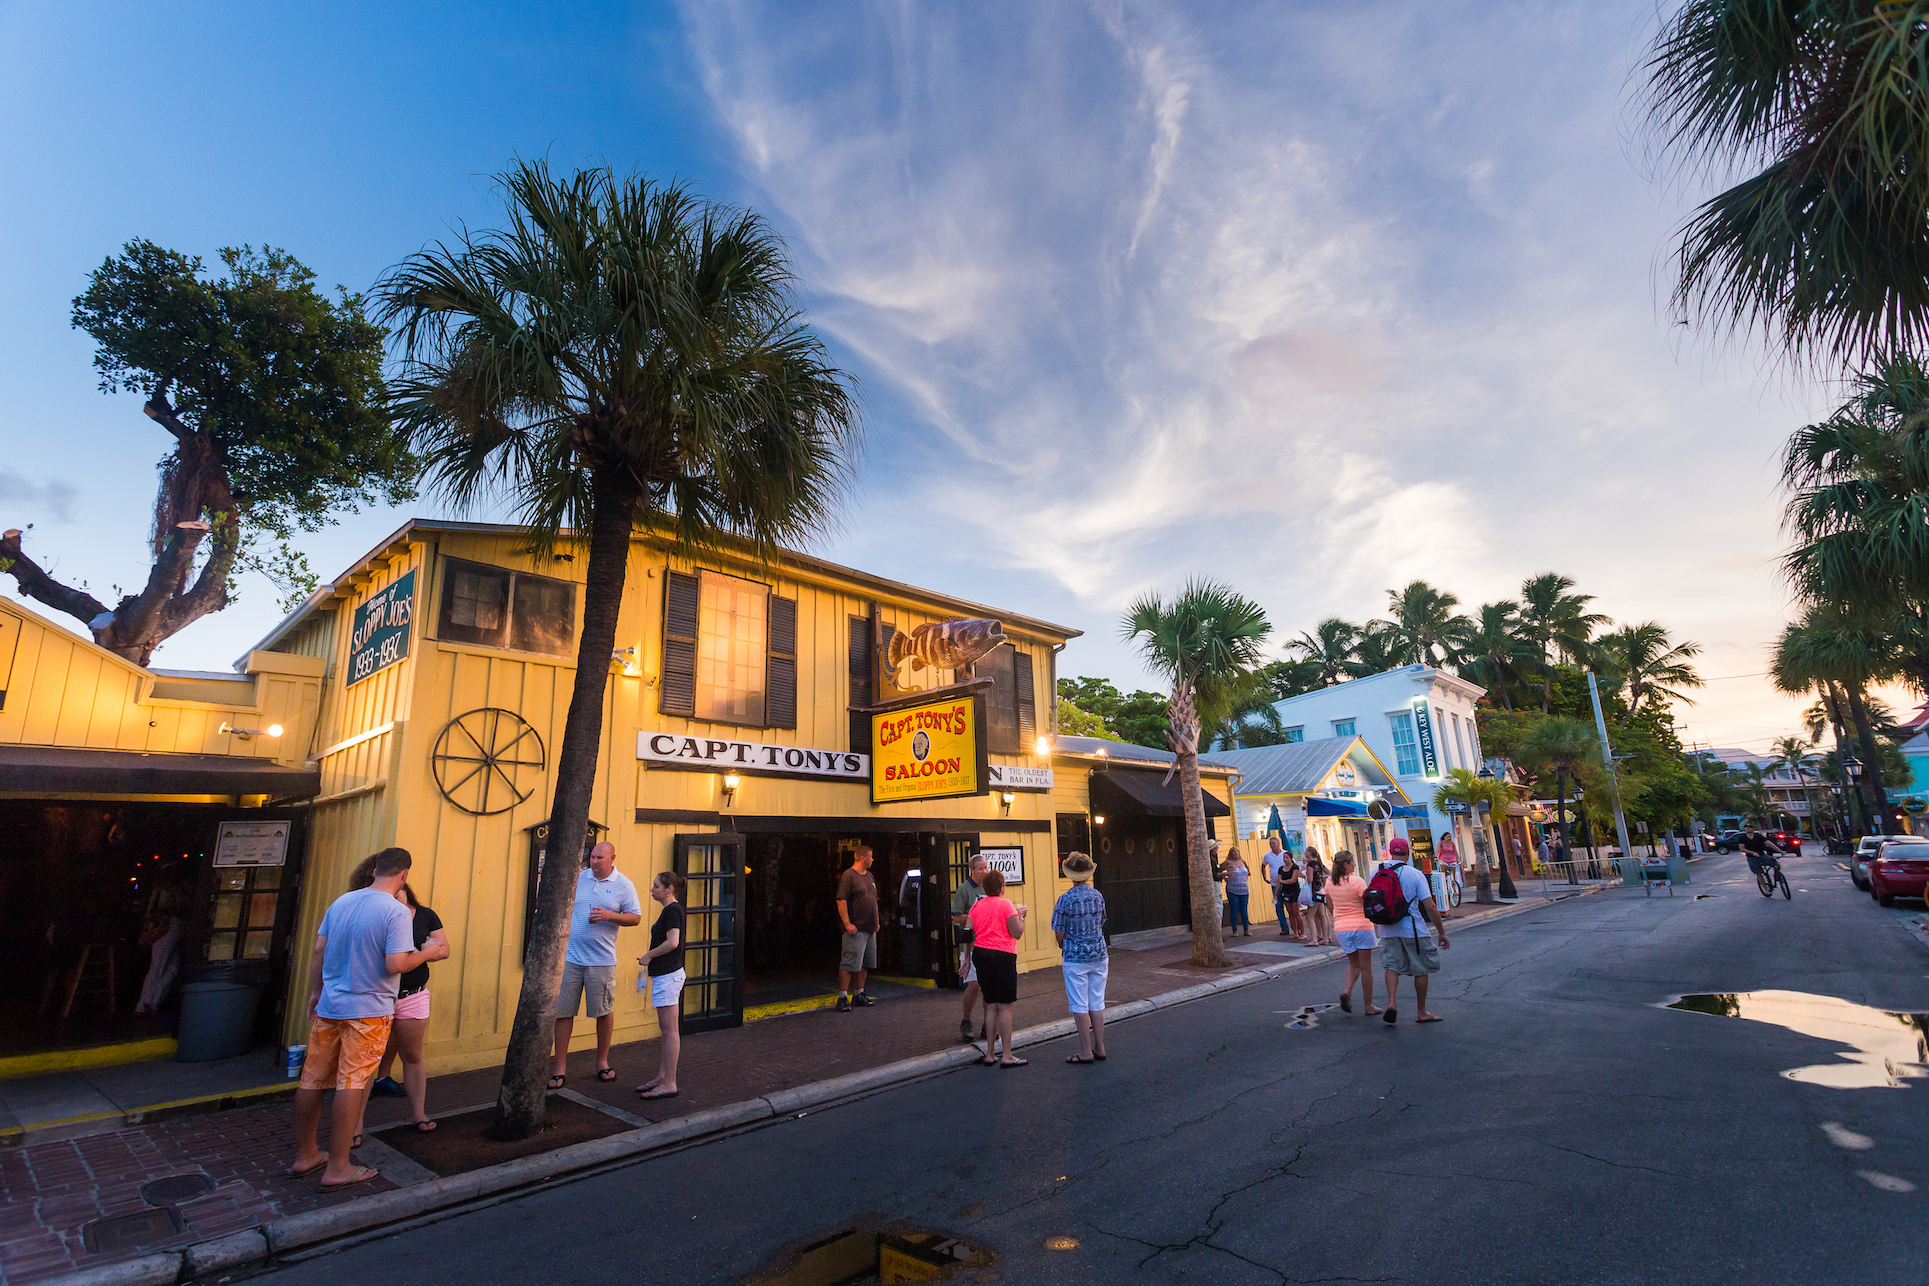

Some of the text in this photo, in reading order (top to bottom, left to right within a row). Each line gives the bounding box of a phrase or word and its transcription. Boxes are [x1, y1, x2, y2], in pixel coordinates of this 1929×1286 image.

[366, 584, 398, 615] Home of
[352, 594, 412, 655] SLOPPY JOE'S
[880, 706, 966, 746] CAPT. TONY'S
[650, 735, 861, 772] CAPT. TONY'S
[1418, 714, 1436, 773] KEY WEST ALOE
[885, 757, 961, 781] SALOON
[1024, 769, 1049, 777] OLDEST
[917, 780, 934, 791] SLOPPY
[935, 779, 947, 790] JOE'S
[998, 851, 1017, 860] TONY'S
